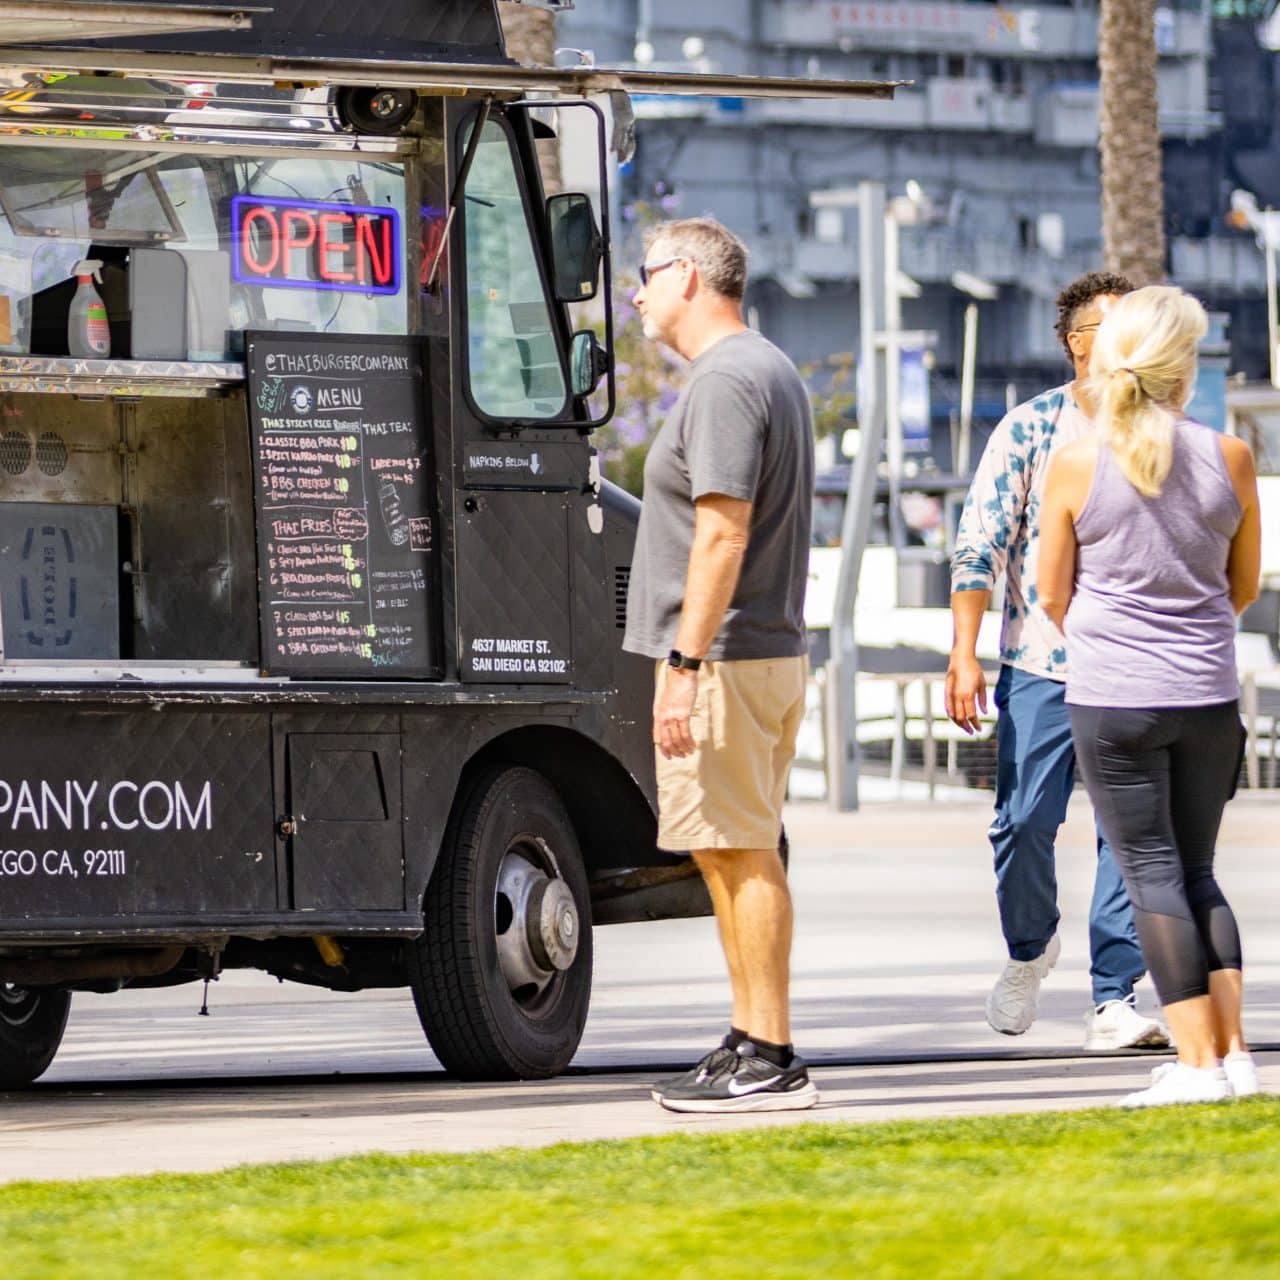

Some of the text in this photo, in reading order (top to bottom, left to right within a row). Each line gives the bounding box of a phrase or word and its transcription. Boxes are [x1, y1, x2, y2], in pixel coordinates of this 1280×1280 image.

[242, 206, 391, 285] OPEN
[265, 353, 409, 373] @THAIBURGERCOMPANY
[317, 387, 362, 407] MENU
[261, 418, 285, 429] THAI
[362, 422, 413, 435] THAI TEA:
[299, 438, 318, 449] BBQ
[340, 435, 357, 451] $10
[335, 453, 351, 468] $10
[470, 456, 503, 468] NAPKINS
[296, 477, 331, 489] CHICKEN
[272, 520, 300, 537] THAI
[300, 519, 332, 533] FRIES
[472, 639, 551, 654] 4637 MARKET ST.
[472, 658, 565, 673] SAN DIEGO CA 92102
[42, 850, 78, 878] CA,
[83, 850, 126, 875] 92111
